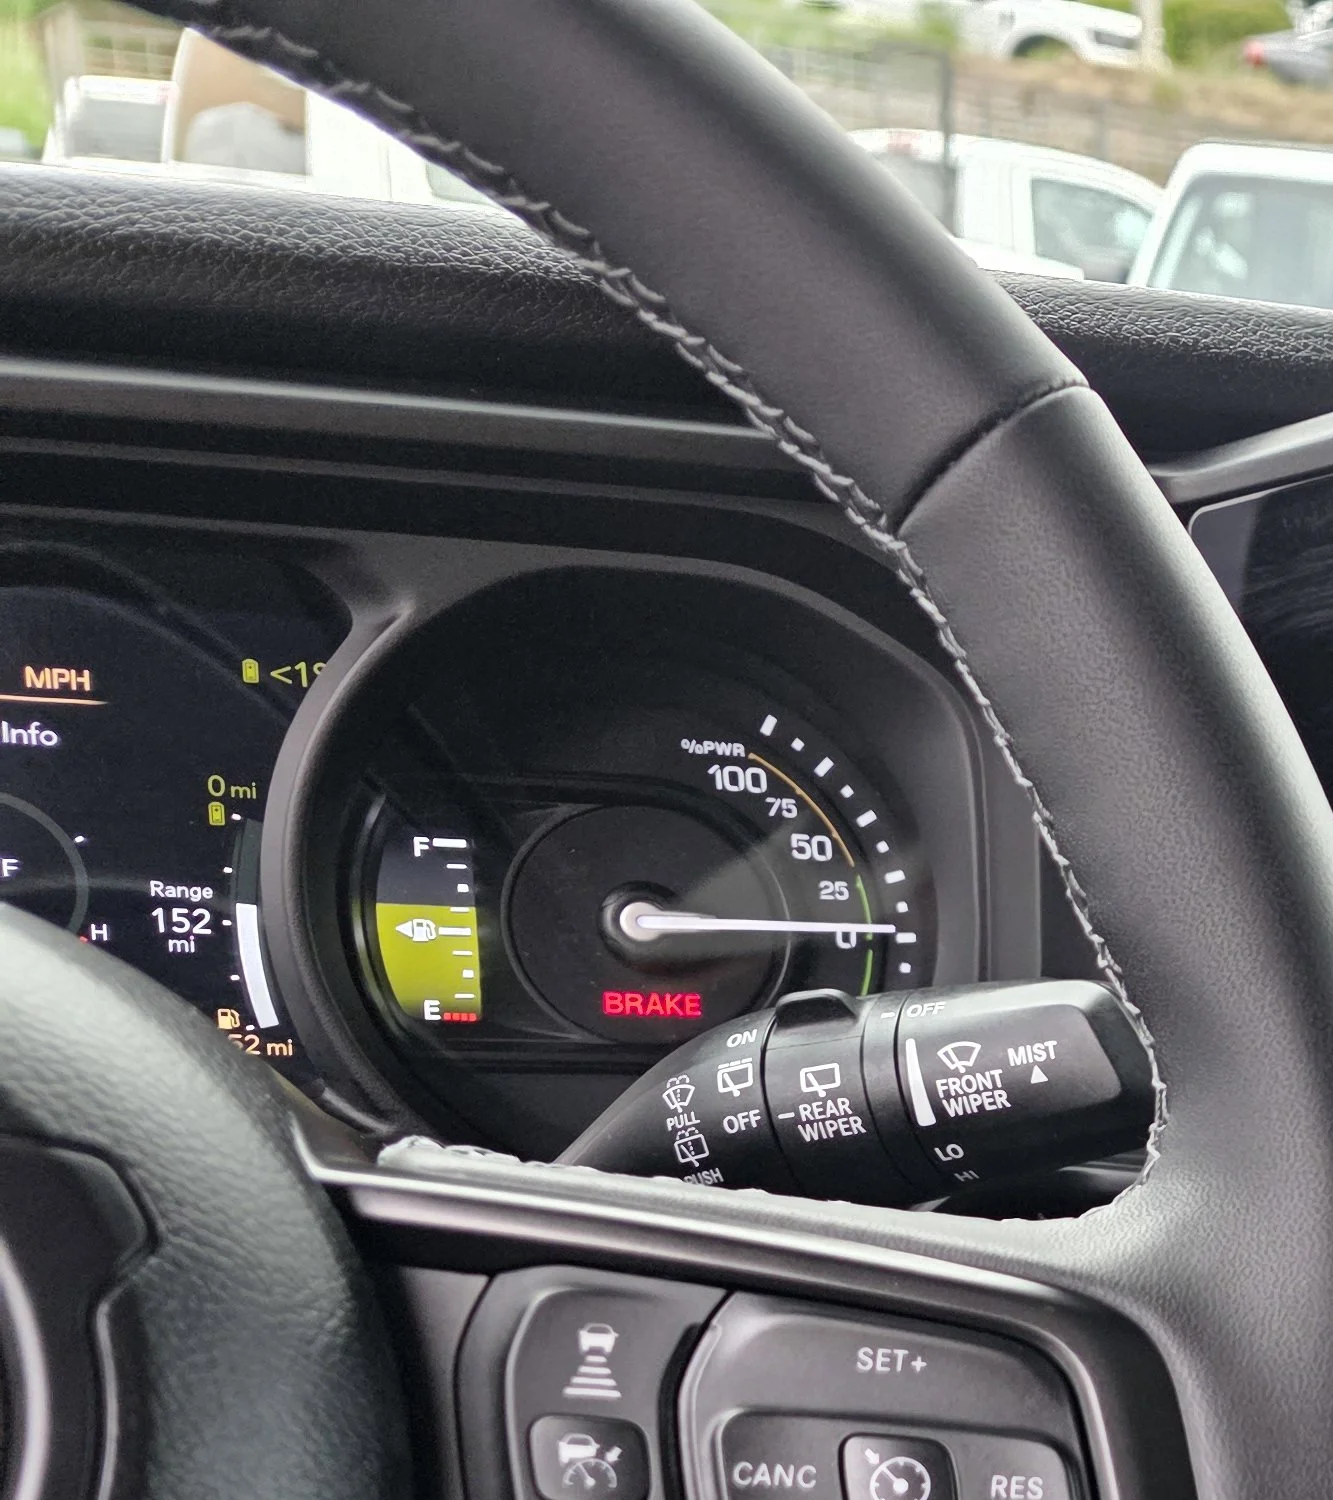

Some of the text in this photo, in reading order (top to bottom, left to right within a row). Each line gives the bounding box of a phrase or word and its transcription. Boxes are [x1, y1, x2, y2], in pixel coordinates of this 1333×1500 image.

[24, 665, 91, 692] MPH
[1, 721, 58, 748] Info
[680, 738, 746, 758] %PWR
[208, 775, 256, 799] 0 mi
[707, 764, 767, 794] 100
[765, 797, 798, 819] 75
[414, 836, 430, 856] F
[790, 833, 832, 861] 50
[150, 880, 213, 901] Range
[819, 880, 850, 901] 25
[90, 924, 108, 941] H
[151, 907, 212, 935] 152
[168, 936, 195, 953] mi
[424, 1000, 440, 1021] E
[602, 991, 703, 1017] BRAKE
[906, 1001, 947, 1018] OFF
[267, 1038, 293, 1057] mi
[726, 1029, 758, 1048] ON
[1007, 1040, 1058, 1066] MIST
[935, 1069, 1003, 1099] FRONT
[799, 1097, 853, 1122] REAR
[941, 1090, 1012, 1118] WIPER
[666, 1111, 700, 1131] PULL
[722, 1109, 762, 1134] OFF
[797, 1115, 867, 1143] WIPER
[934, 1143, 964, 1162] LO
[954, 1170, 980, 1182] HI
[733, 1461, 817, 1489] CANC
[990, 1474, 1044, 1500] RES
